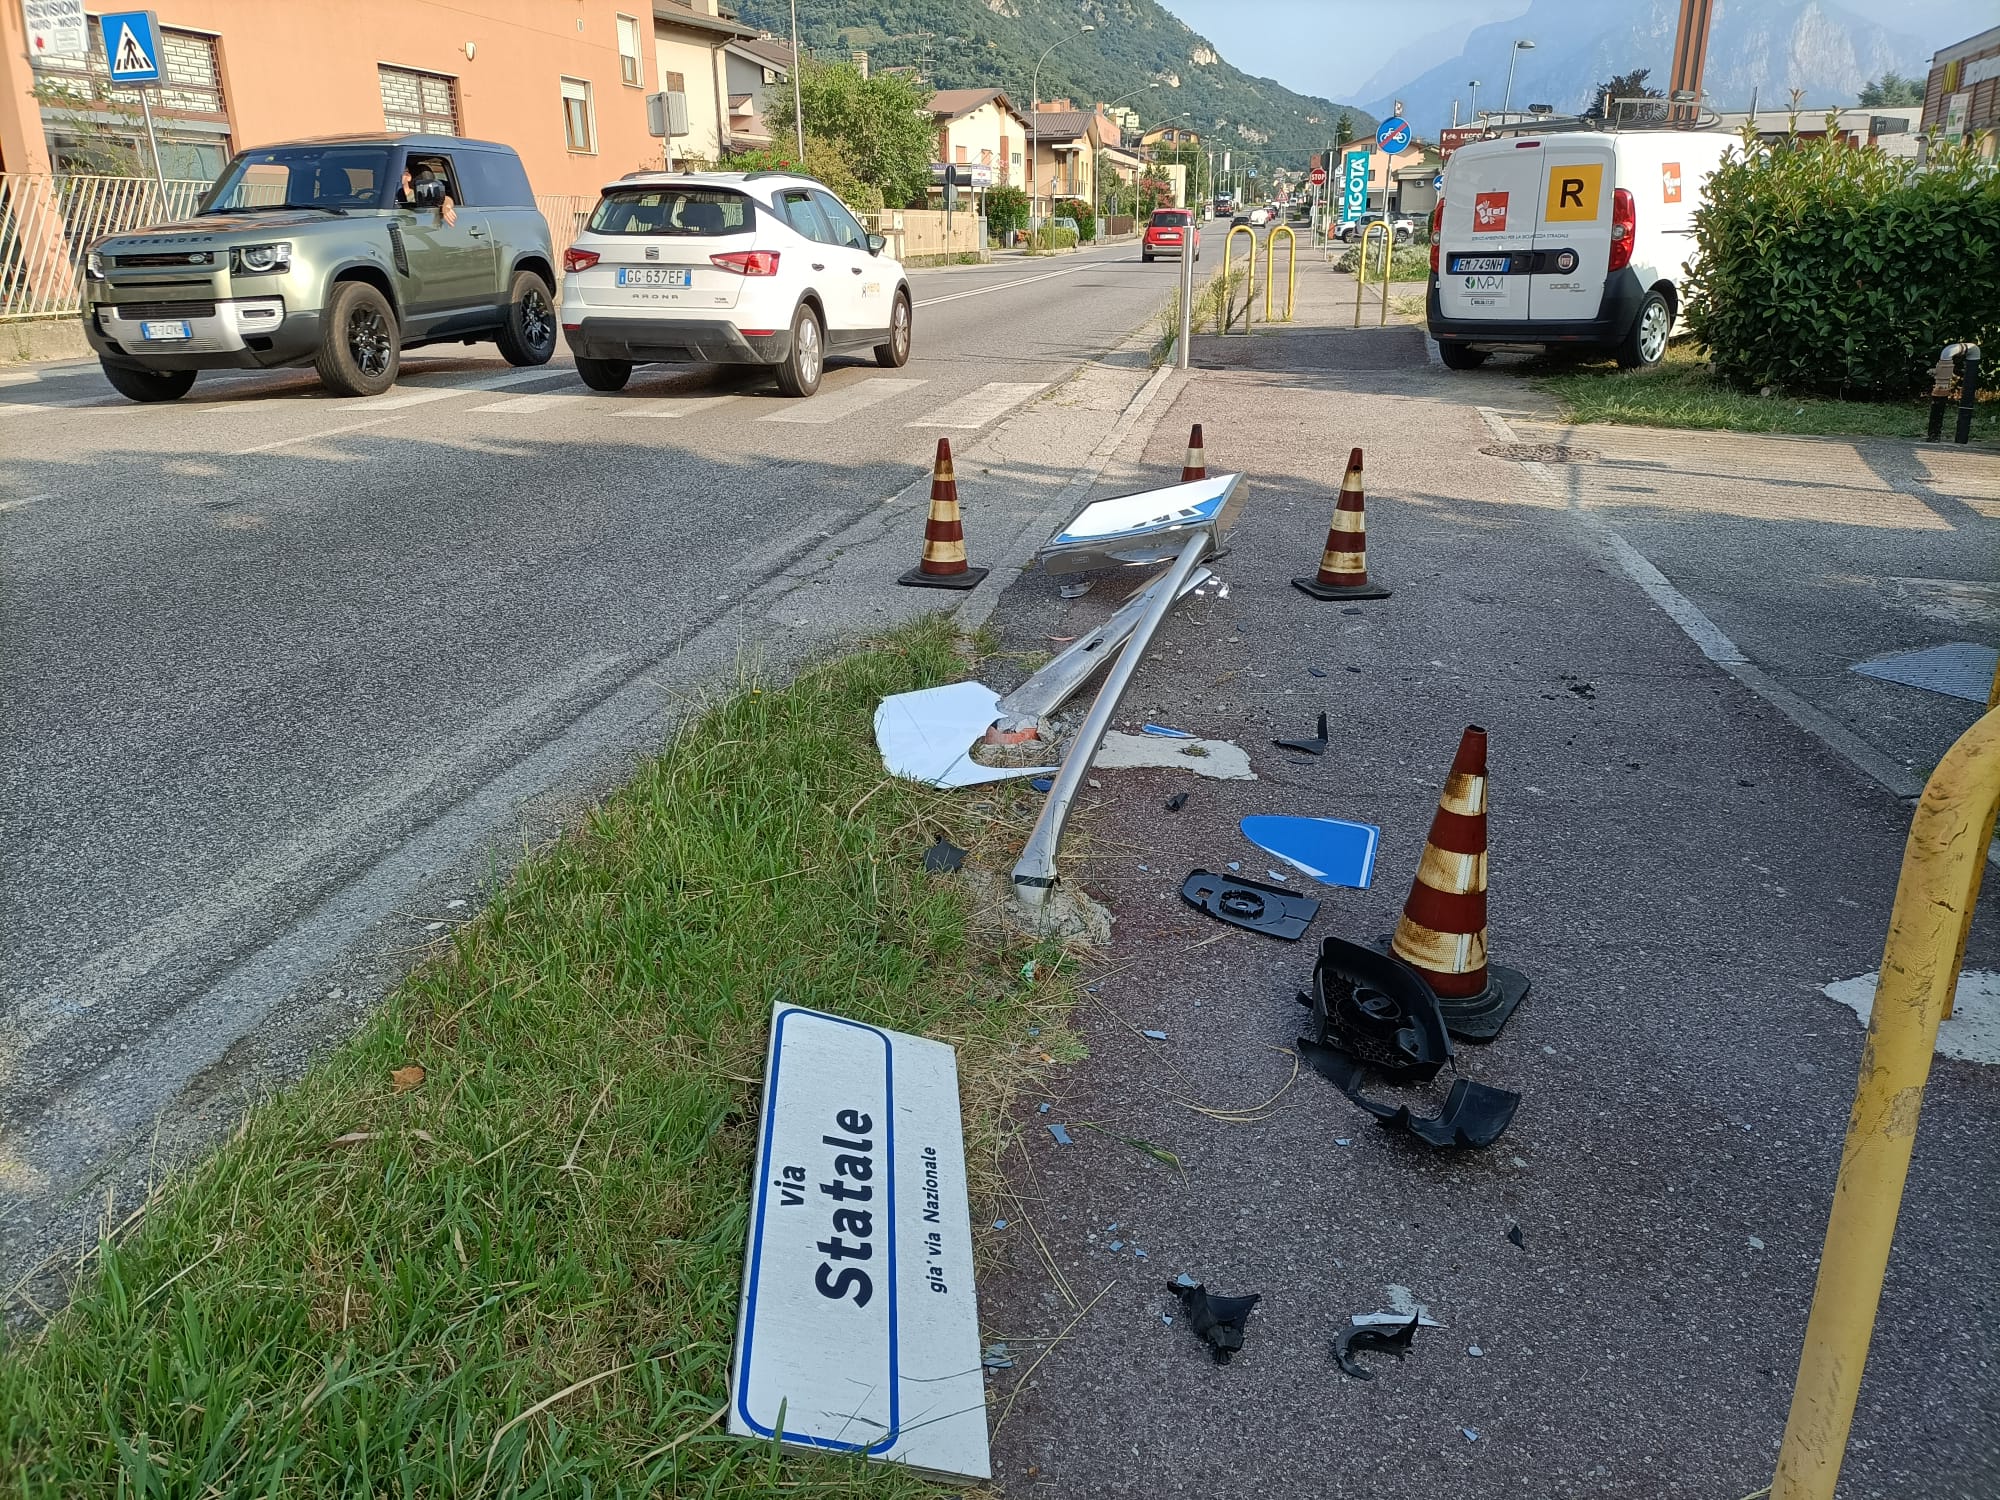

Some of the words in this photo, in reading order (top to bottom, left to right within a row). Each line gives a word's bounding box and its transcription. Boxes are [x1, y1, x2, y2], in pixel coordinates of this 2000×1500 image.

[26, 0, 81, 18] REVISIONI
[1311, 173, 1326, 181] STOP
[1559, 178, 1585, 208] R
[117, 236, 214, 246] DEFENDER
[773, 1165, 806, 1206] via
[920, 1146, 940, 1223] Nazionale
[815, 1108, 873, 1309] Statale
[924, 1232, 941, 1256] via
[925, 1260, 947, 1294] gia'
